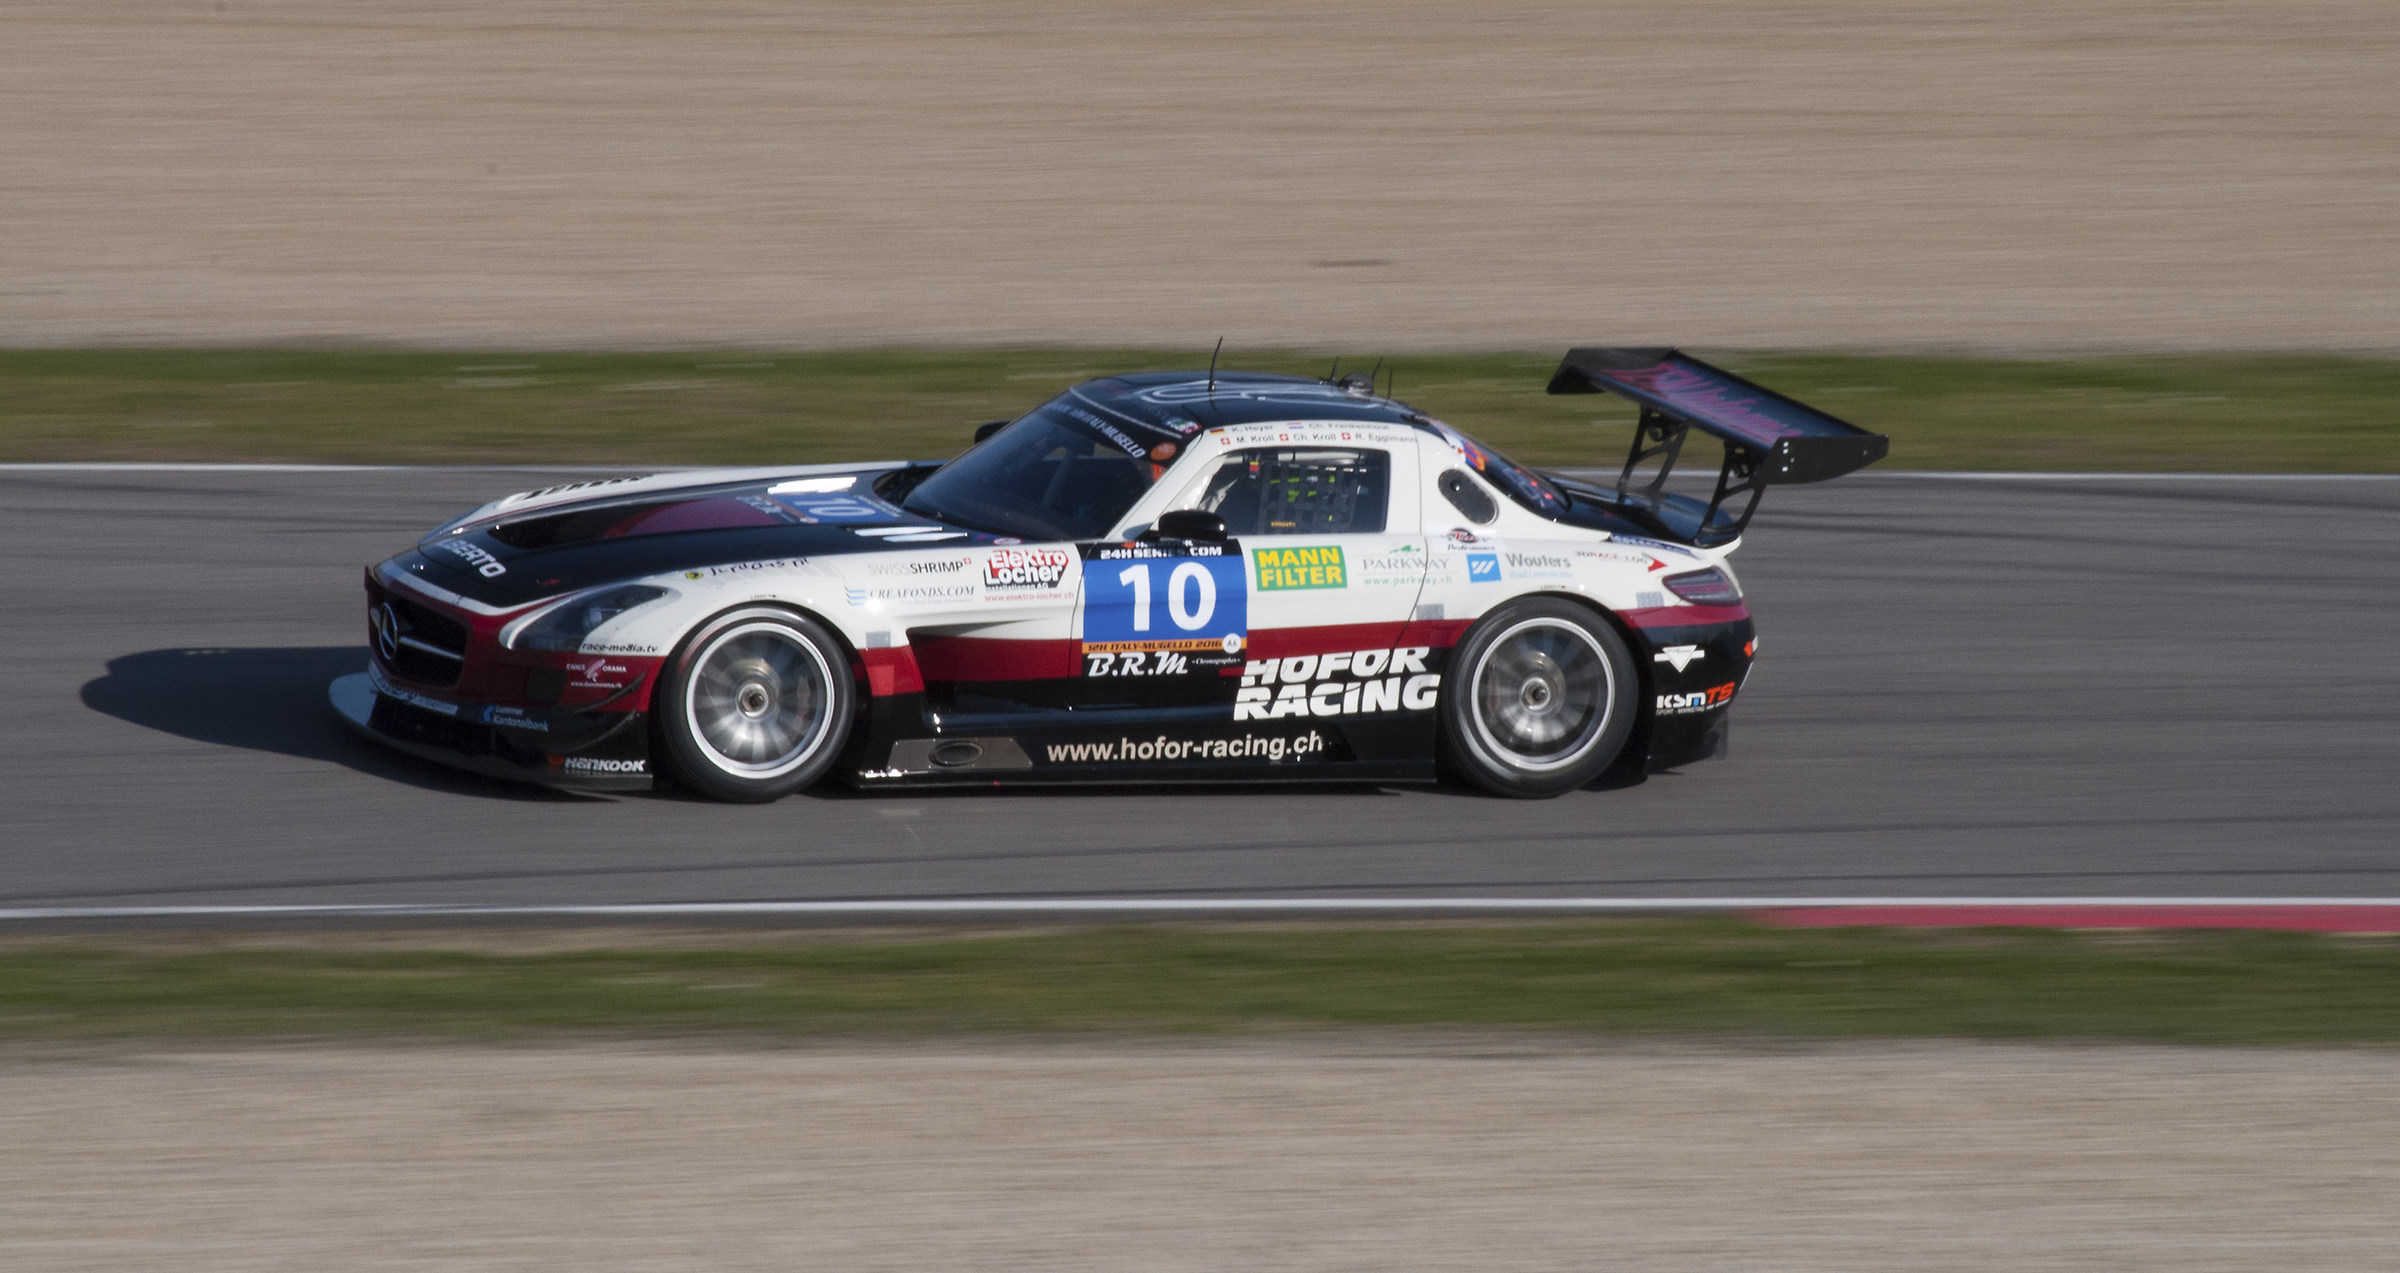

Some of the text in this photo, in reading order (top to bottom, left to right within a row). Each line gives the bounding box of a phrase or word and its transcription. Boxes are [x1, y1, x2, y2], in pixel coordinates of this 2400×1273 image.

[1250, 434, 1275, 442] Kroll
[1312, 432, 1337, 441] Kroll
[1257, 547, 1340, 568] MANN
[1362, 557, 1451, 571] PARKWAY
[1505, 552, 1571, 569] Wouters
[985, 560, 1063, 586] Locher
[1260, 565, 1343, 588] FILTER
[1364, 575, 1453, 587] www.parkway.ch
[1118, 561, 1217, 632] 10
[1241, 646, 1431, 688] HOFOR
[1233, 673, 1442, 721] RACING
[492, 714, 549, 732] Kantonalbank
[1046, 729, 1324, 762] www.hofor-racing.ch
